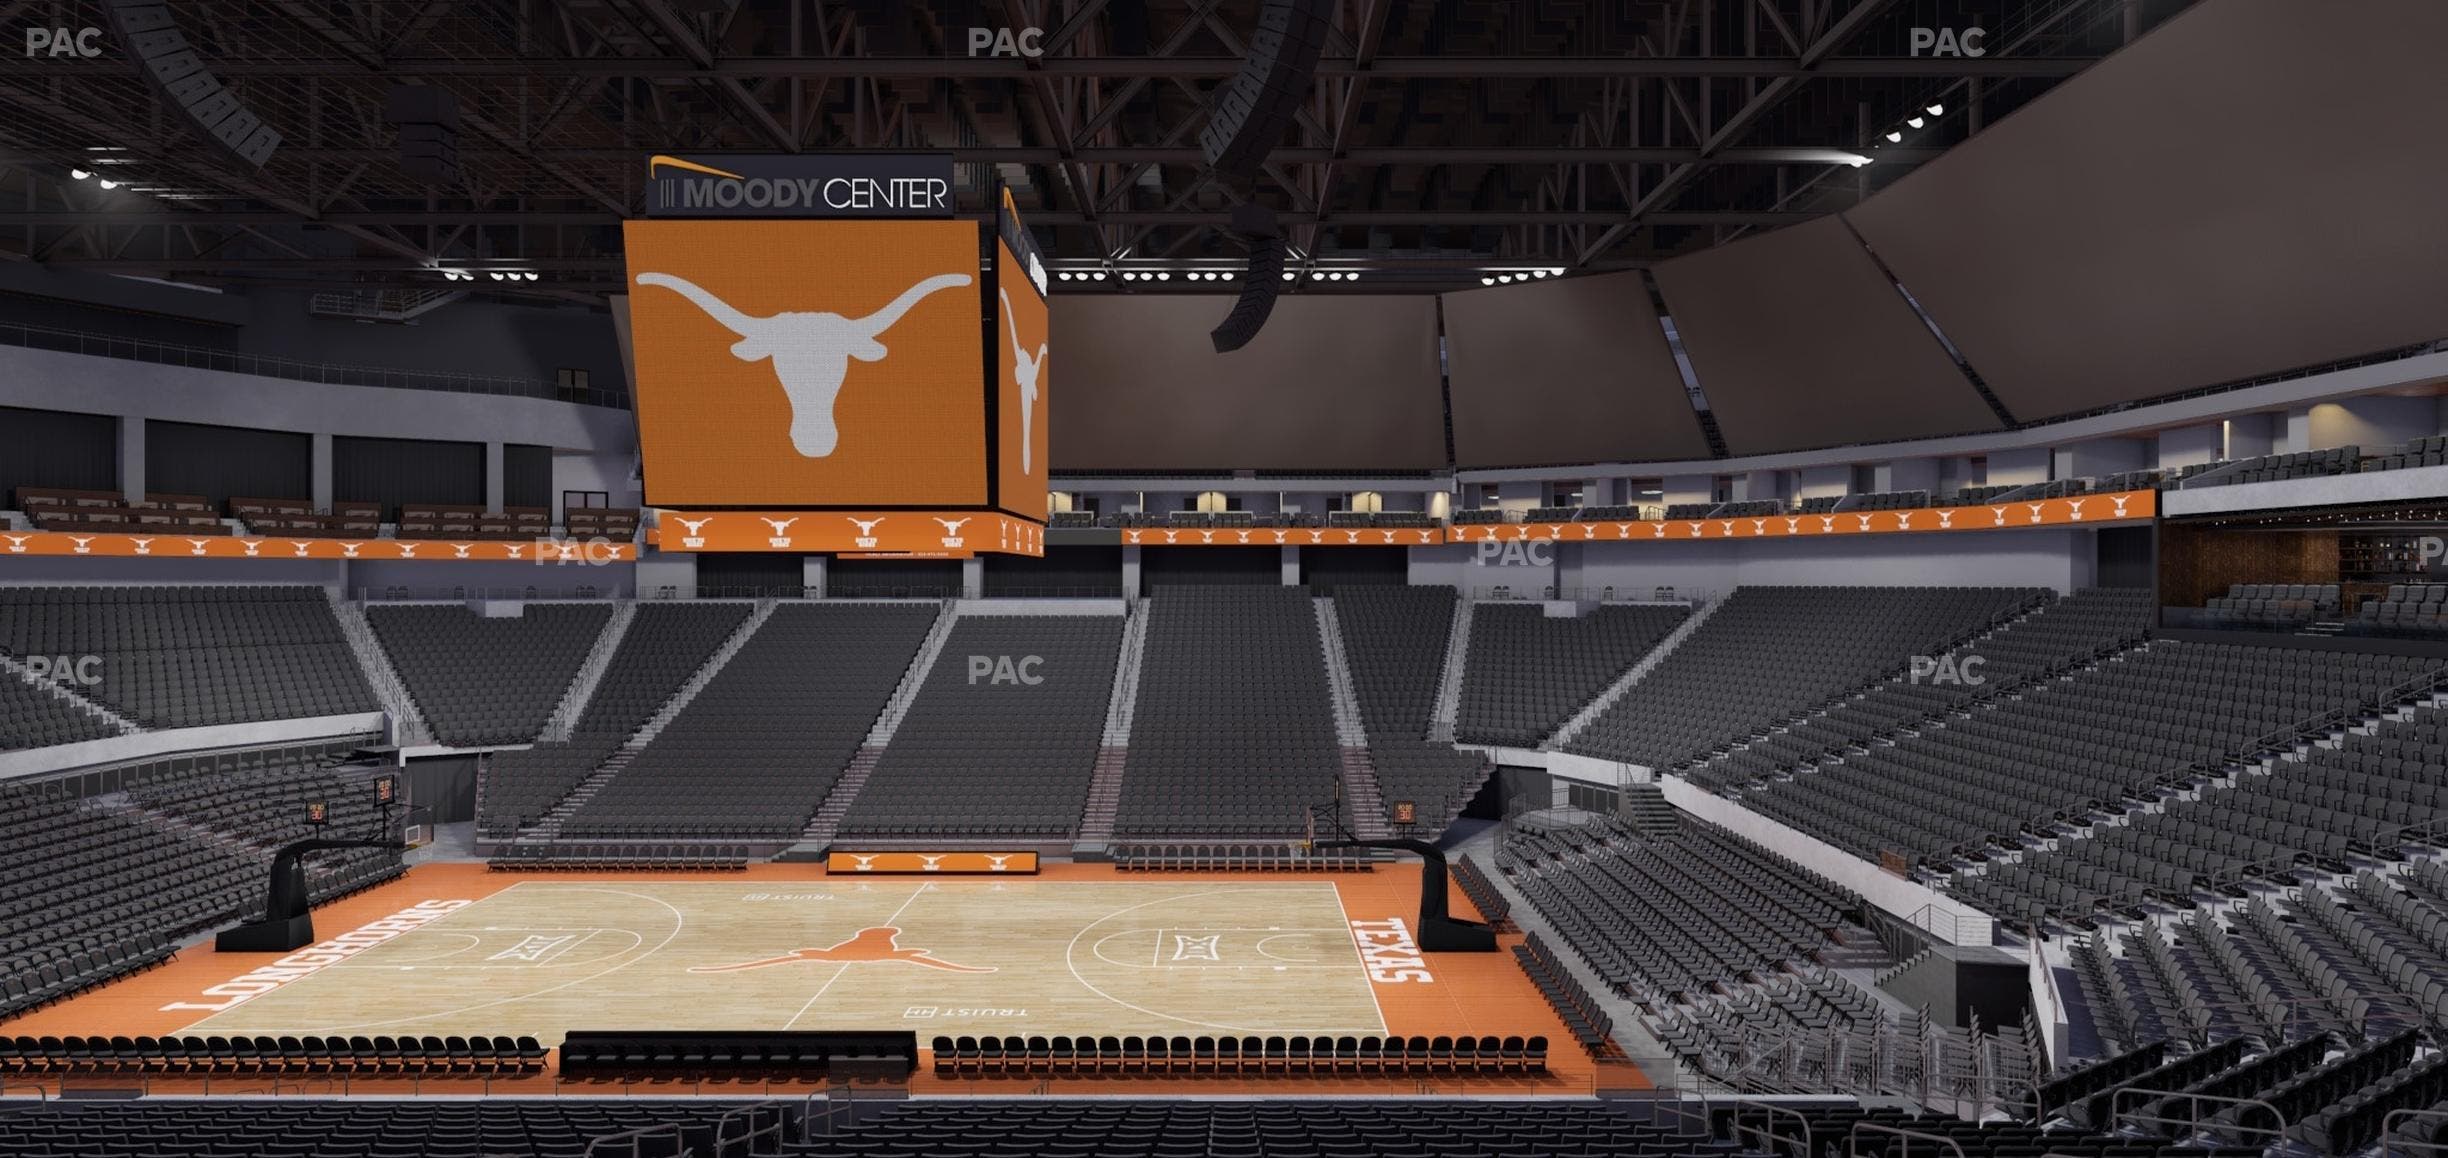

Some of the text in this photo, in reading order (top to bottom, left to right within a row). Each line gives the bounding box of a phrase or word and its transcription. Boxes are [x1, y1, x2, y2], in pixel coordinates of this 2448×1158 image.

[683, 178, 948, 208] MOODY CENTER
[157, 899, 473, 1012] LONGHORNS
[1350, 917, 1434, 983] TEXAS
[941, 1007, 1029, 1017] TRUIST
